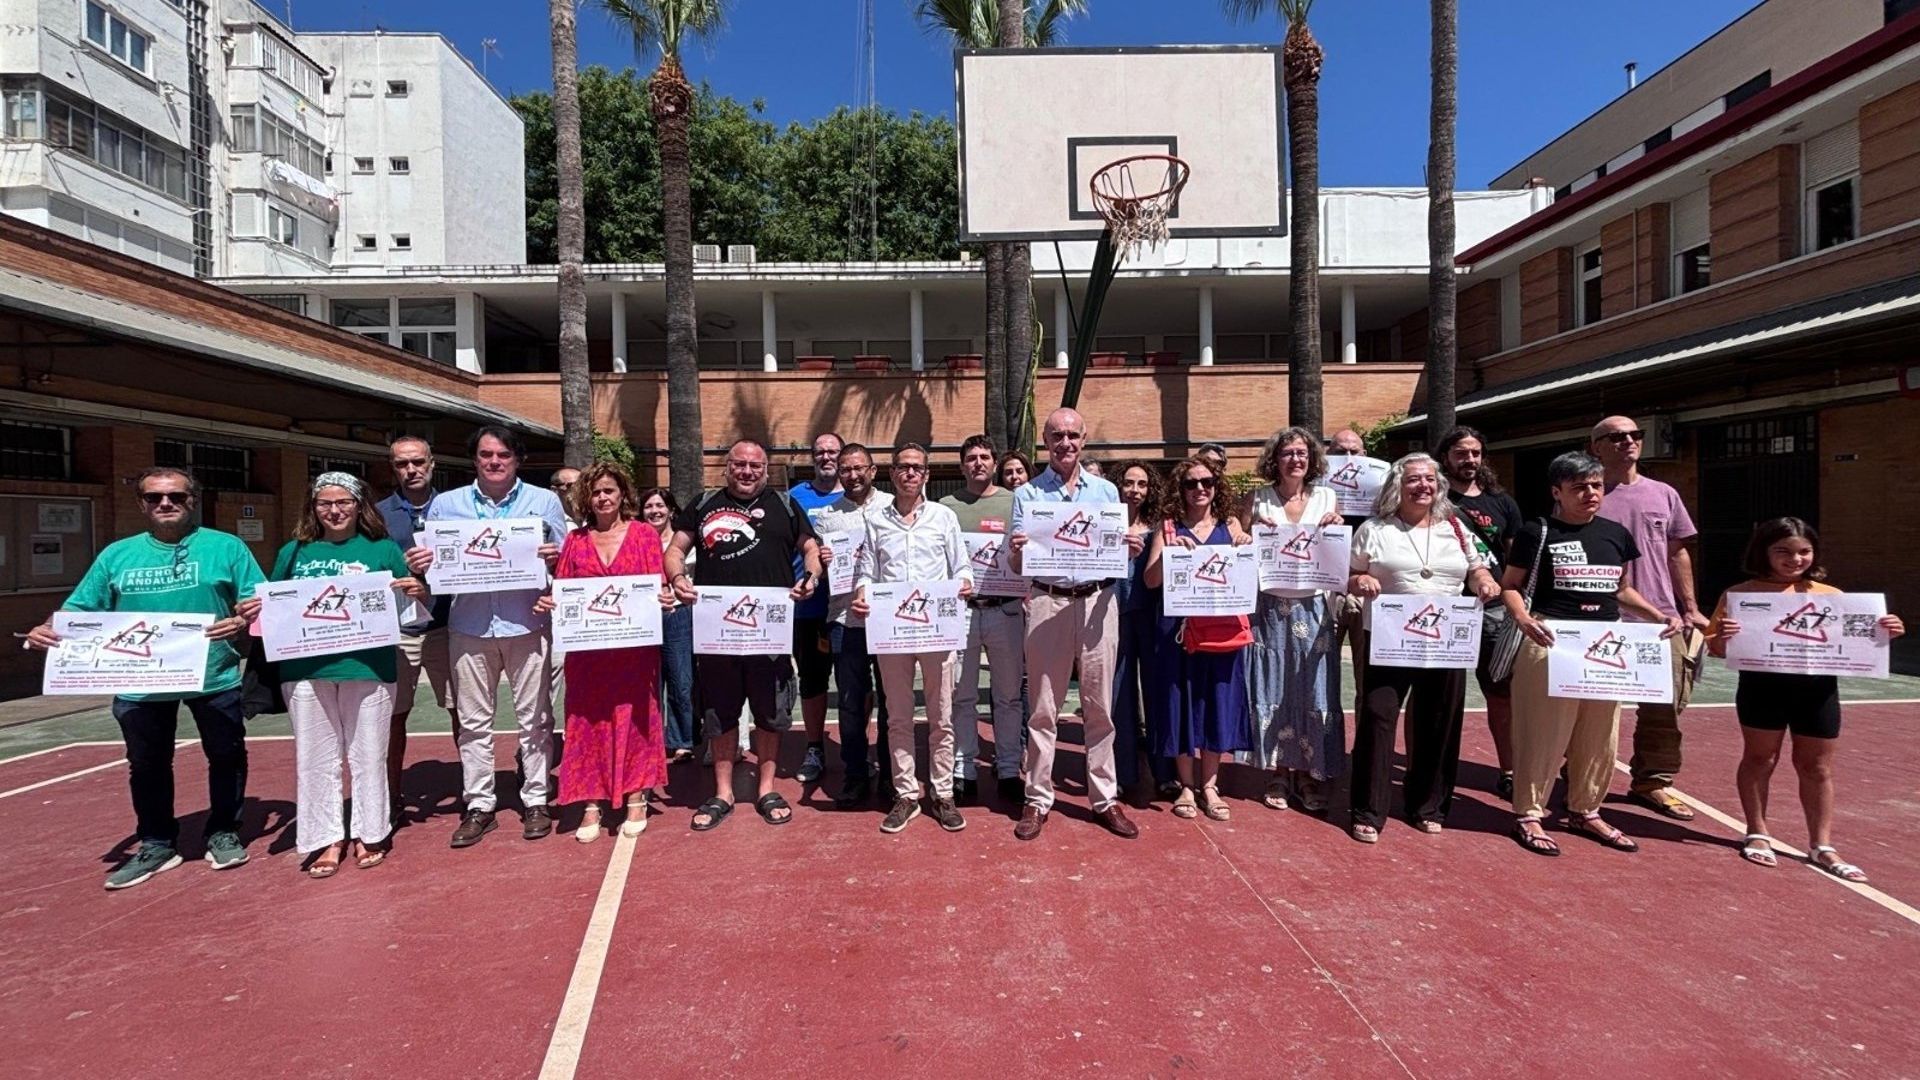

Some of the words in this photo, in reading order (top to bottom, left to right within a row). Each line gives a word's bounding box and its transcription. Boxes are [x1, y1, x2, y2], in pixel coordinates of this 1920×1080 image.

[713, 532, 740, 542] CGT
[720, 552, 735, 560] CGT
[127, 568, 172, 579] HECHO
[1555, 580, 1616, 589] DEFIENDES
